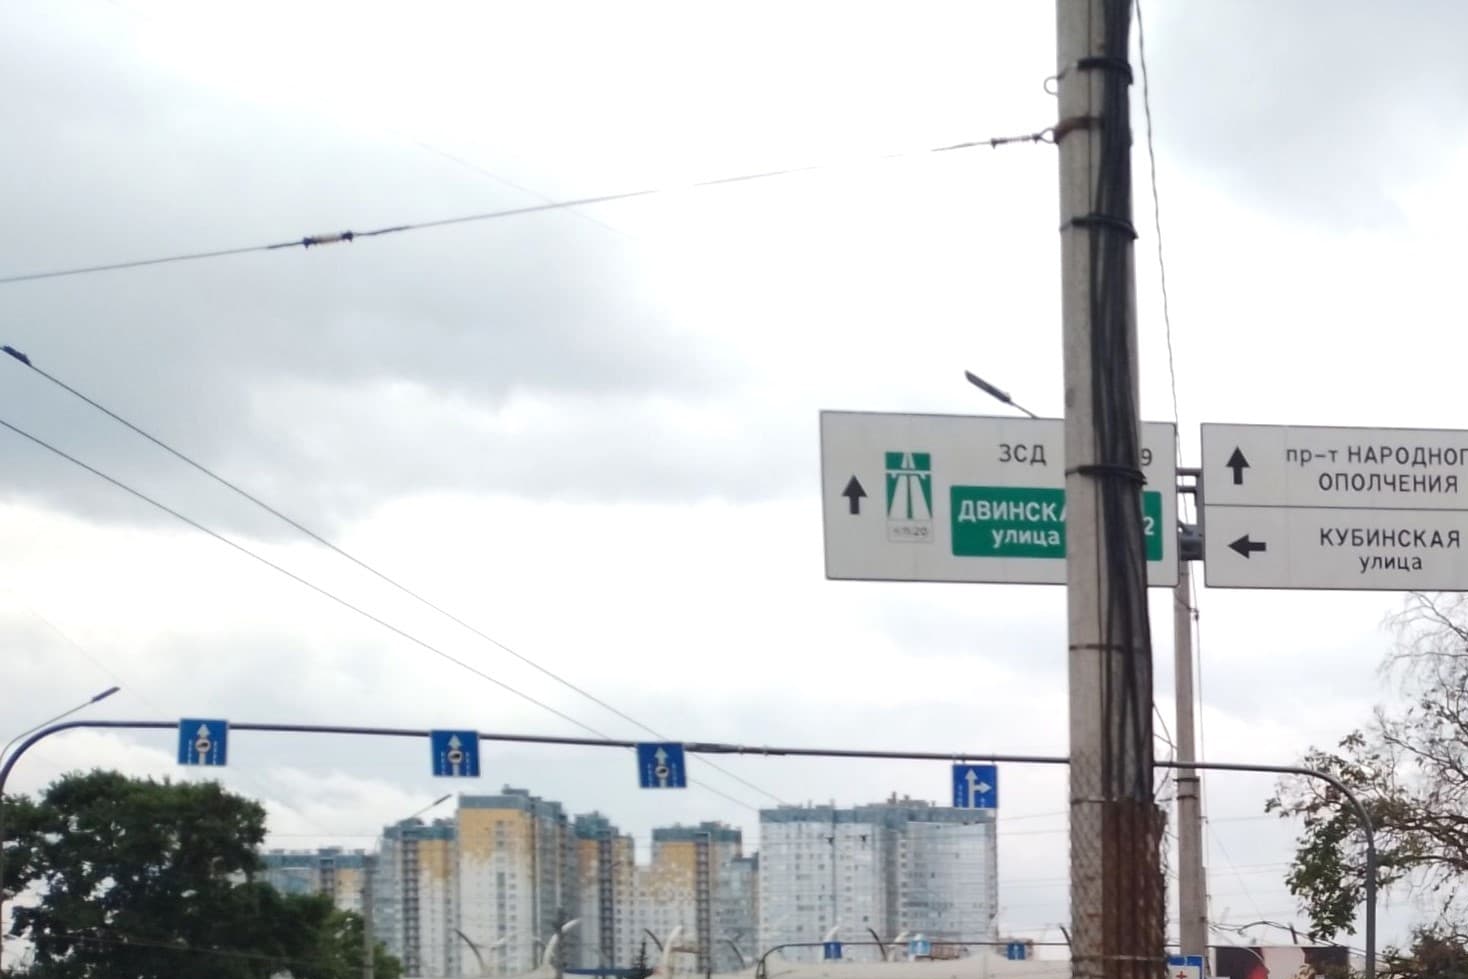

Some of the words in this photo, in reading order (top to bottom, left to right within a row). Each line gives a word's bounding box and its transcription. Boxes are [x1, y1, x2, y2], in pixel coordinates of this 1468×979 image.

[999, 443, 1047, 466] ЗСД
[1286, 448, 1338, 466] пр-т
[1318, 472, 1459, 494] ОПОЛЧЕНИЯ
[957, 499, 1067, 523] ДВИНСК
[991, 529, 1061, 549] улица
[1319, 527, 1461, 549] КУБИНСКАЯ
[1358, 555, 1424, 575] улица
